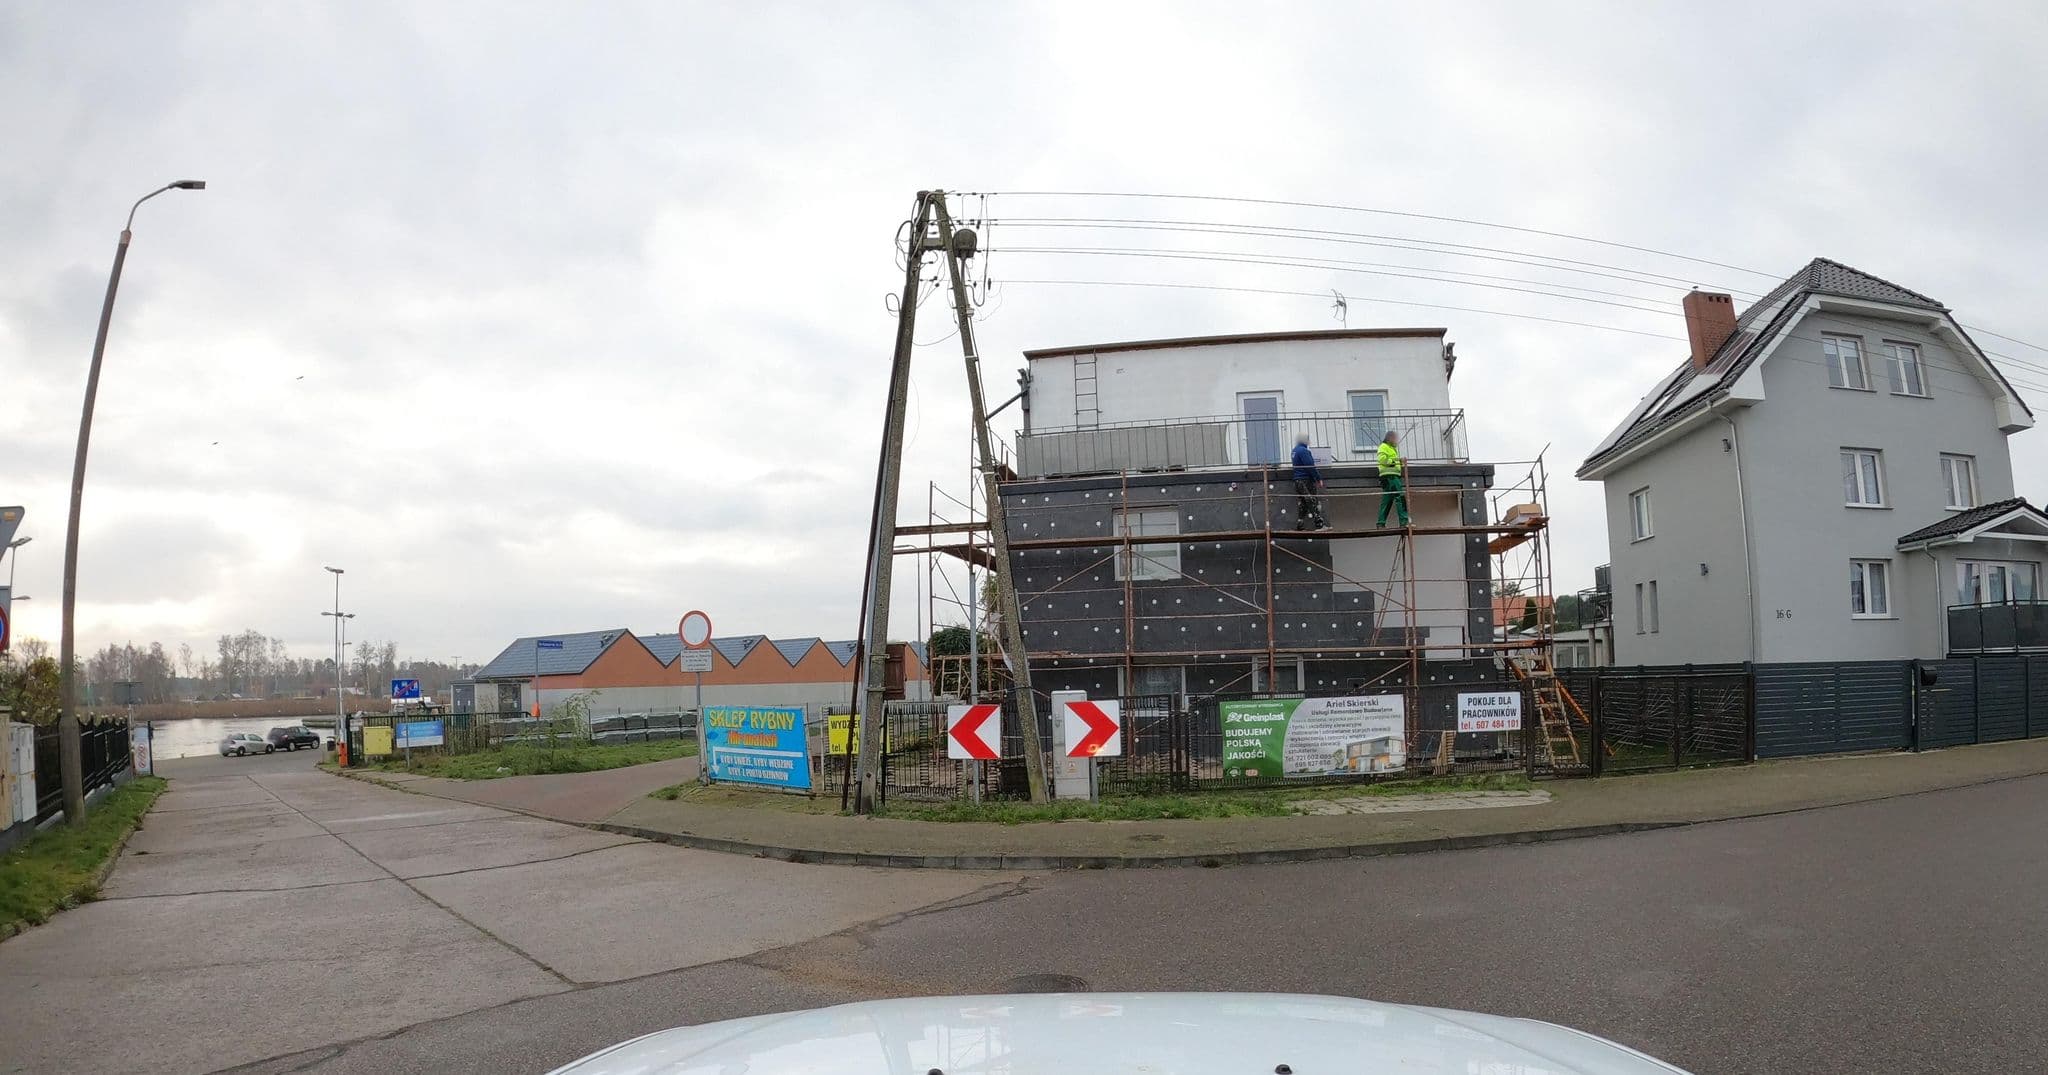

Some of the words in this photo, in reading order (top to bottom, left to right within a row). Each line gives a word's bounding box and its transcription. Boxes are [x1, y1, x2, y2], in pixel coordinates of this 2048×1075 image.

[1786, 609, 1792, 619] G
[1326, 700, 1345, 708] Ariel
[1346, 699, 1379, 707] Skierski
[1467, 696, 1496, 706] POKOJE
[1498, 696, 1512, 705] DLA
[1243, 712, 1285, 722] Greinplast
[1462, 706, 1517, 718] PRACOWNIKÓW
[709, 709, 747, 728] SKLEP
[750, 710, 795, 731] RYBNY
[1461, 721, 1474, 730] tel.
[1476, 720, 1489, 729] 607
[1492, 720, 1504, 728] 484
[1507, 719, 1519, 728] 101
[1225, 727, 1272, 737] BUDUJEMY
[1226, 738, 1262, 748] POLSKĄ
